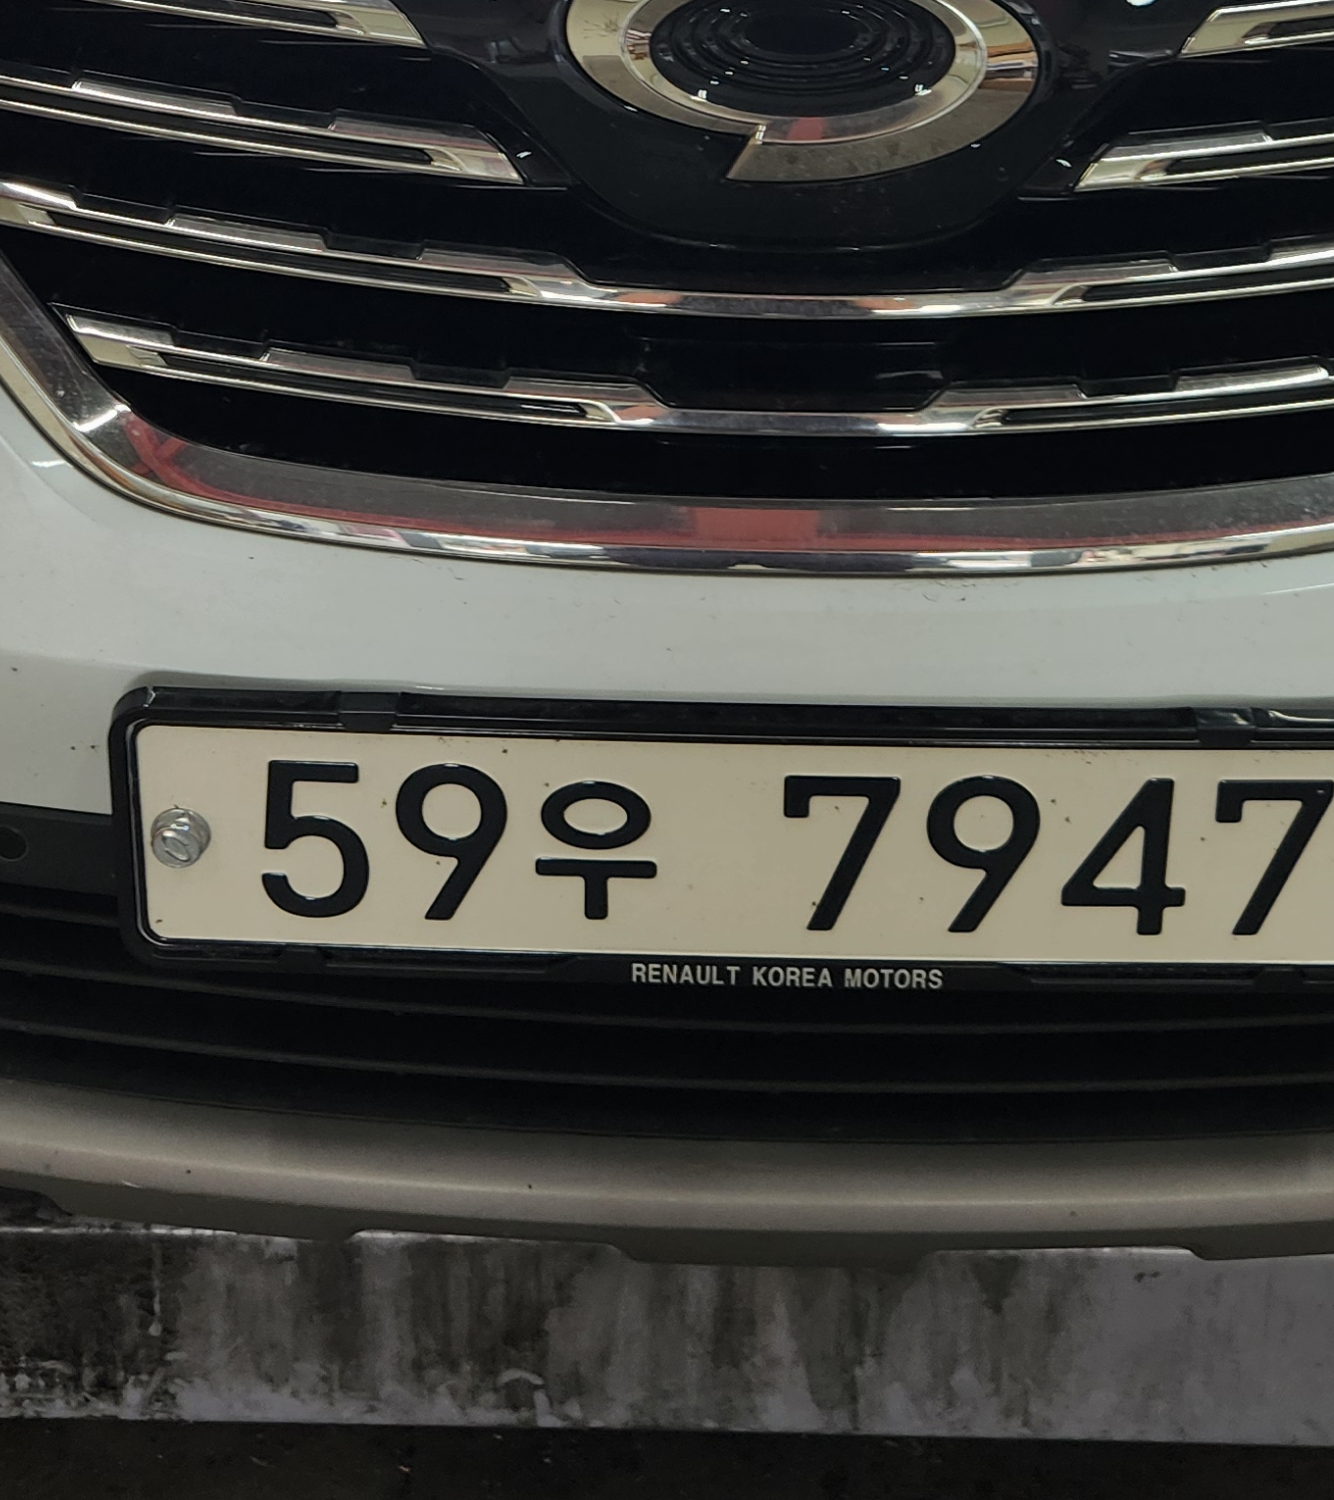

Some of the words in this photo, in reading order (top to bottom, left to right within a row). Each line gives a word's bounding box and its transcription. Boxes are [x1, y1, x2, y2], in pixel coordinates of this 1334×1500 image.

[261, 759, 658, 921] 59우
[631, 961, 742, 986] RENAULT
[751, 965, 834, 988] KOREA
[843, 967, 944, 990] MOTORS
